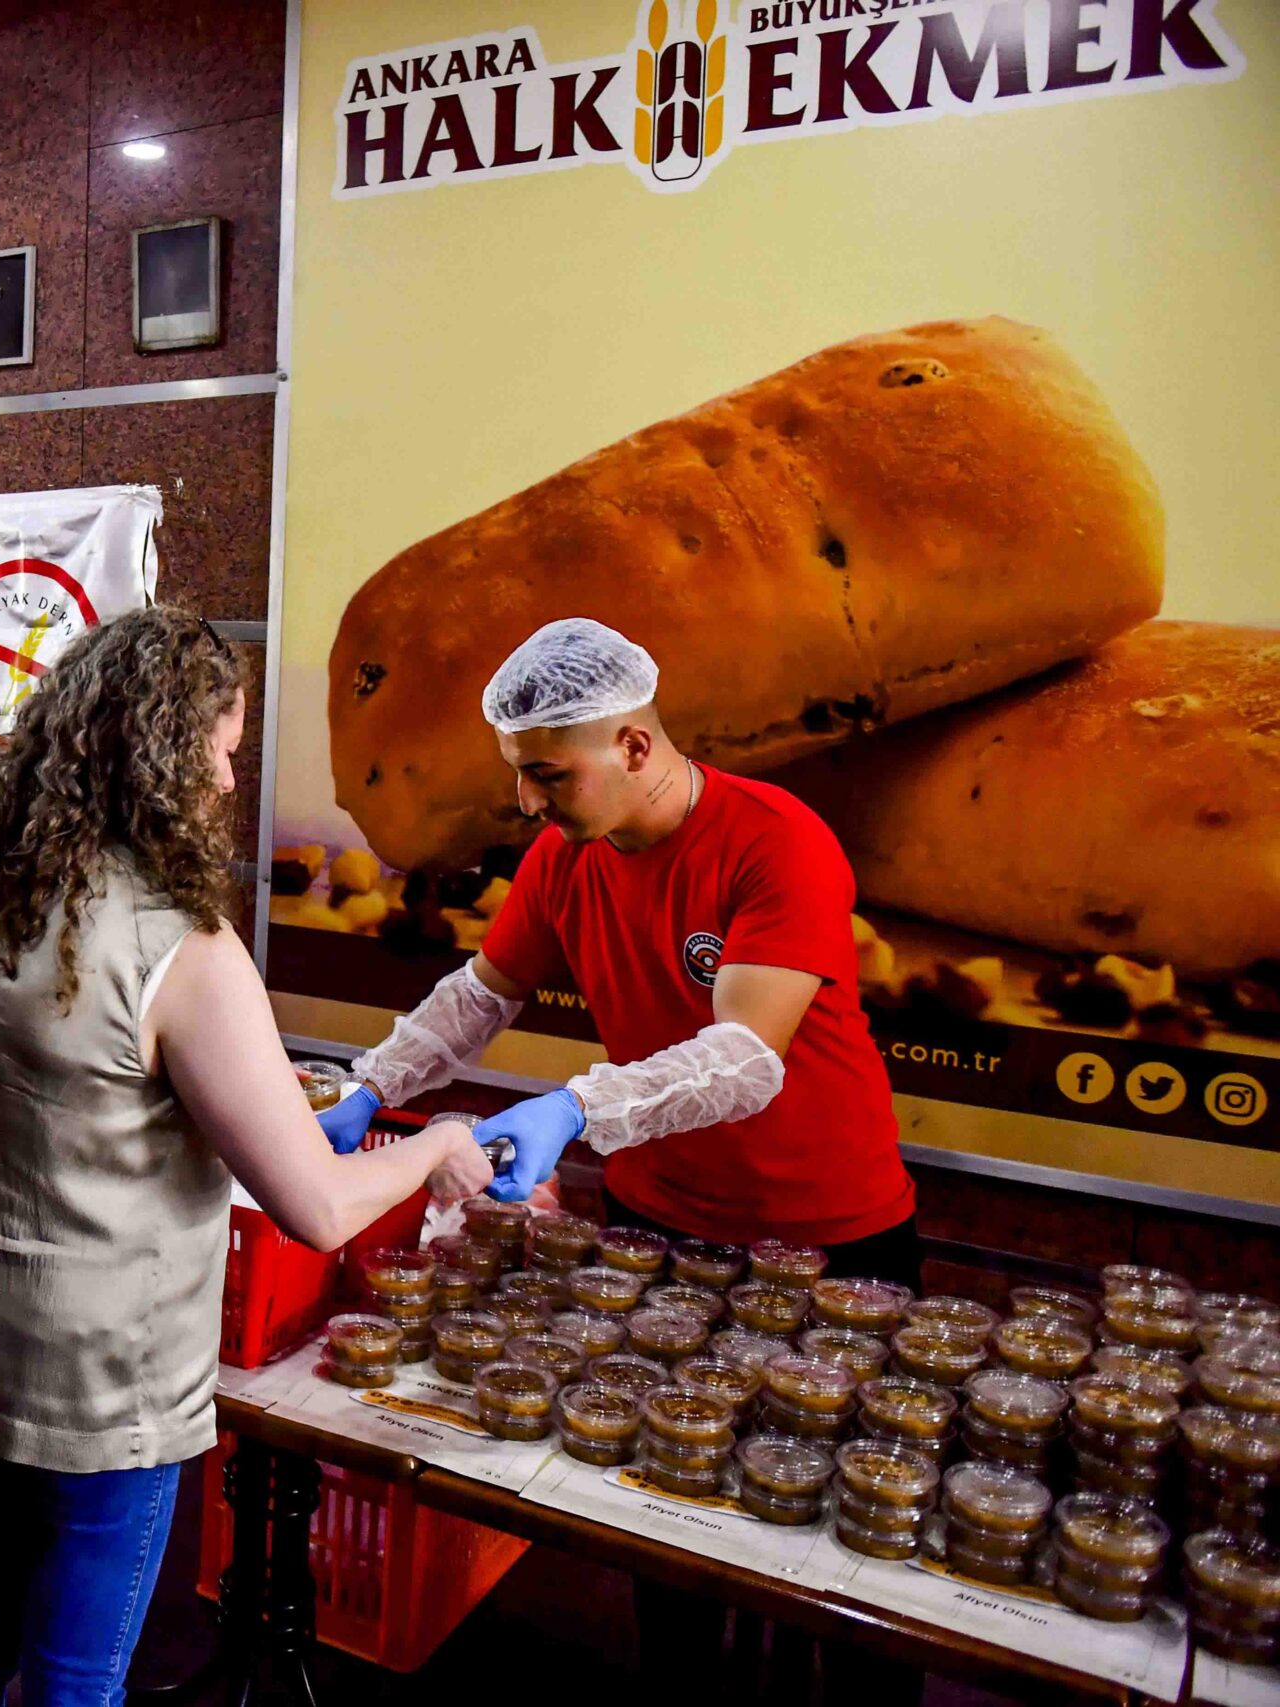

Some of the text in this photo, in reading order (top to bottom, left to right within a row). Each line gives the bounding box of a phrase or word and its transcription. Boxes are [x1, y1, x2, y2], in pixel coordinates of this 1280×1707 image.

[348, 37, 538, 104] ANKARA
[342, 0, 1229, 190] HALK EKMEK
[37, 596, 75, 637] DERN
[376, 1413, 410, 1432] Afiyet
[410, 1425, 446, 1441] Olsun
[642, 1501, 723, 1531] Afiyet Olsun
[953, 1591, 1049, 1626] Afiyet Olsun
